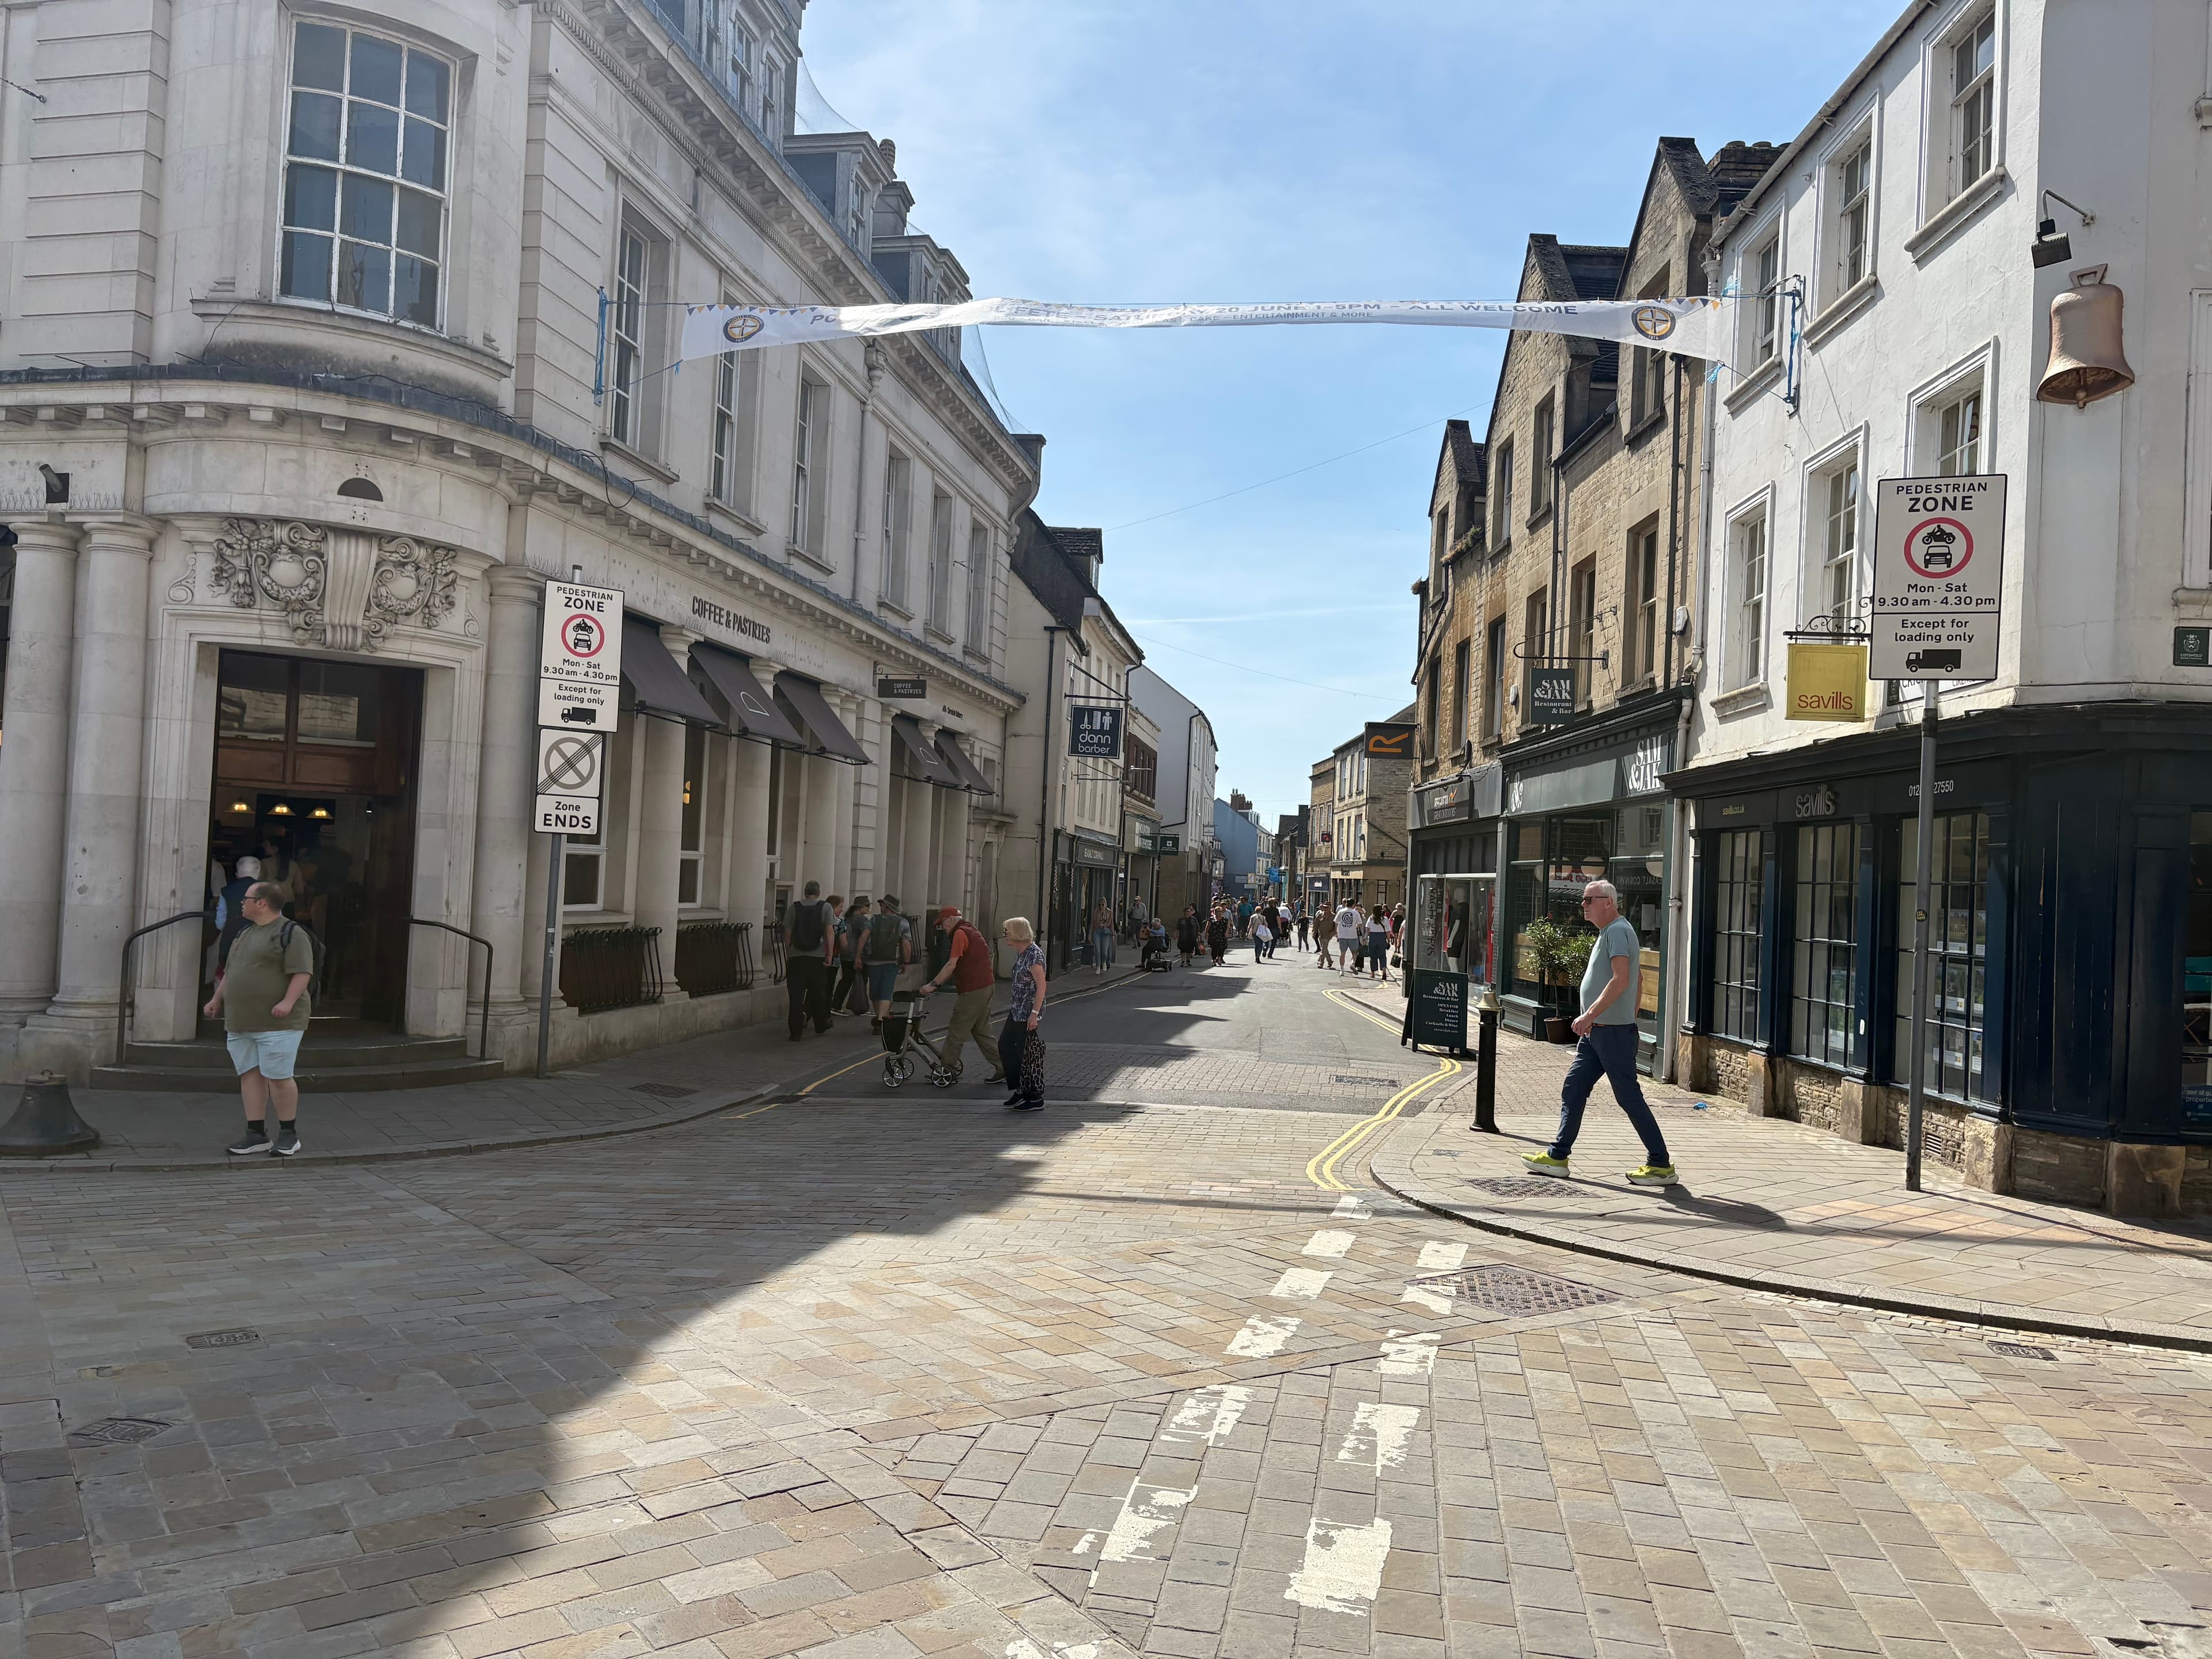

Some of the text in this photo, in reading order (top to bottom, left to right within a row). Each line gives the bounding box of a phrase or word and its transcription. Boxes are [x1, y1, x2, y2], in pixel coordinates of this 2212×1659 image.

[1461, 305, 1578, 315] WELCOME
[1896, 482, 1987, 495] PEDESTRIAN
[1908, 495, 1974, 512] ZONE
[556, 586, 613, 601] PEDESTRIAN
[1907, 584, 1934, 593] Mon
[1944, 582, 1968, 593] Sat
[564, 596, 605, 613] ZONE
[1878, 597, 1909, 607] 9.30
[1911, 598, 1930, 606] am
[1940, 596, 1973, 606] 4.30
[1975, 597, 1995, 607] pm
[692, 596, 771, 644] COFFEE & PASTRIES
[1901, 618, 1969, 630] Except for
[1895, 632, 1974, 643] loading only
[562, 658, 579, 668] Mon
[586, 661, 601, 670] Sat
[543, 666, 564, 675] 9.30
[583, 671, 604, 679] 4.30
[605, 673, 618, 681] pm
[558, 684, 602, 695] Except for
[1541, 679, 1570, 690] SAM
[554, 692, 605, 706] loading only
[1797, 691, 1853, 710] savills
[1079, 730, 1111, 744] dann
[1078, 743, 1110, 755] barber
[1636, 734, 1663, 766] SAM
[555, 801, 581, 812] Zone
[1796, 783, 1836, 818] savills
[543, 813, 592, 829] ENDS
[1438, 982, 1457, 991] SAM
